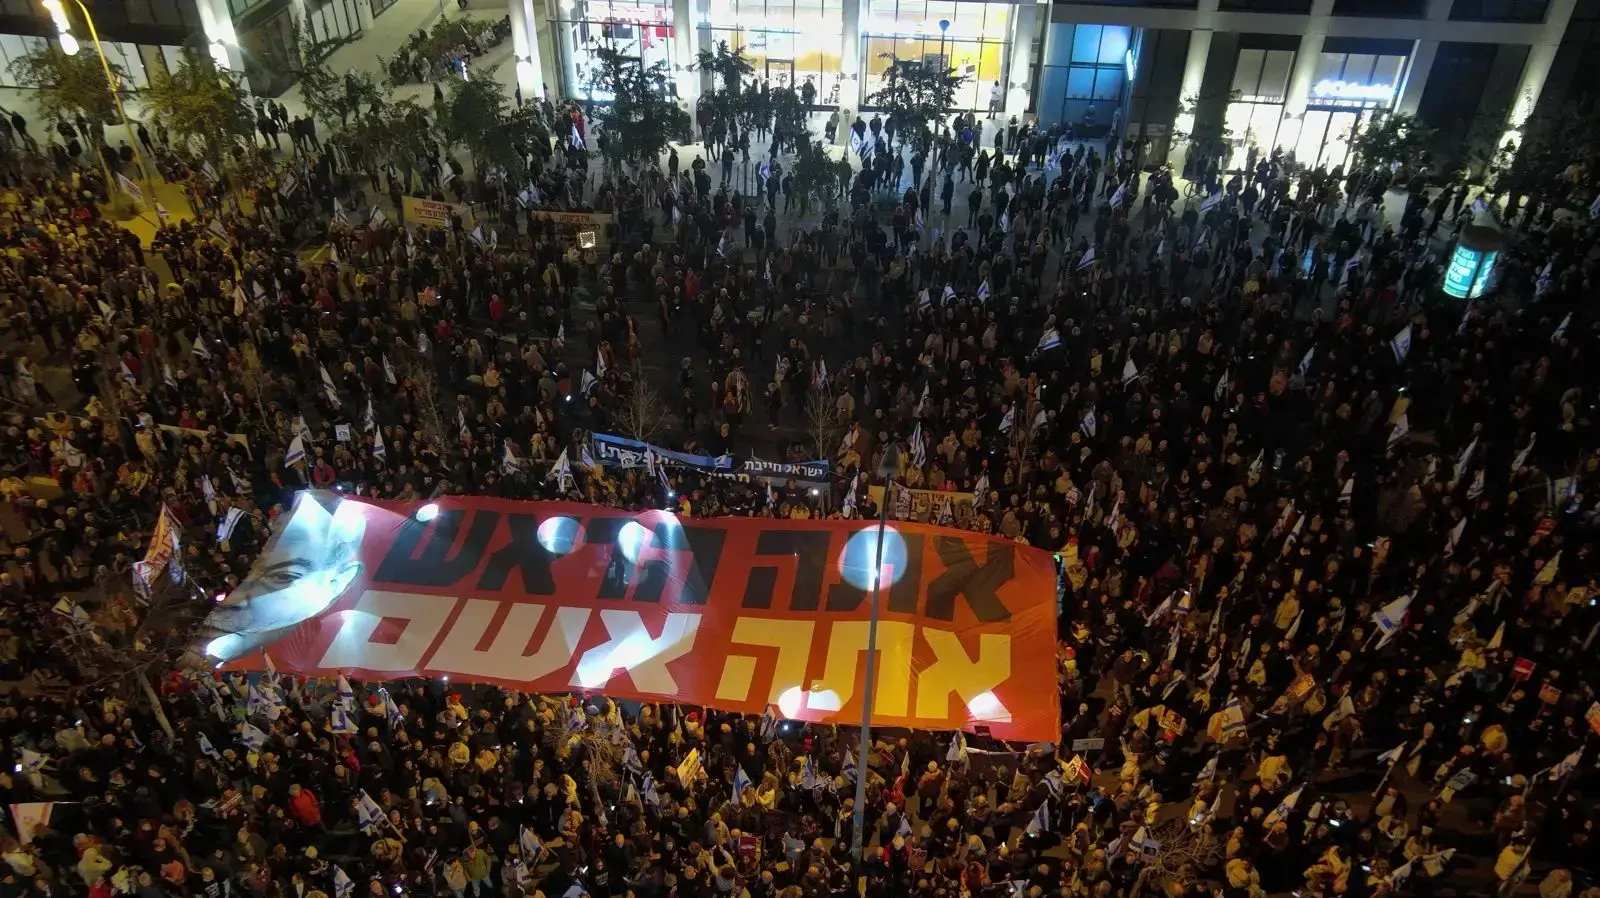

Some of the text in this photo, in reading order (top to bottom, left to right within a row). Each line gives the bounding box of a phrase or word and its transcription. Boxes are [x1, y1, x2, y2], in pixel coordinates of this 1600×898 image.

[744, 459, 824, 478] ישראל חייבת
[371, 508, 1016, 623] אתה הראש
[316, 589, 1012, 723] אתה אשם
